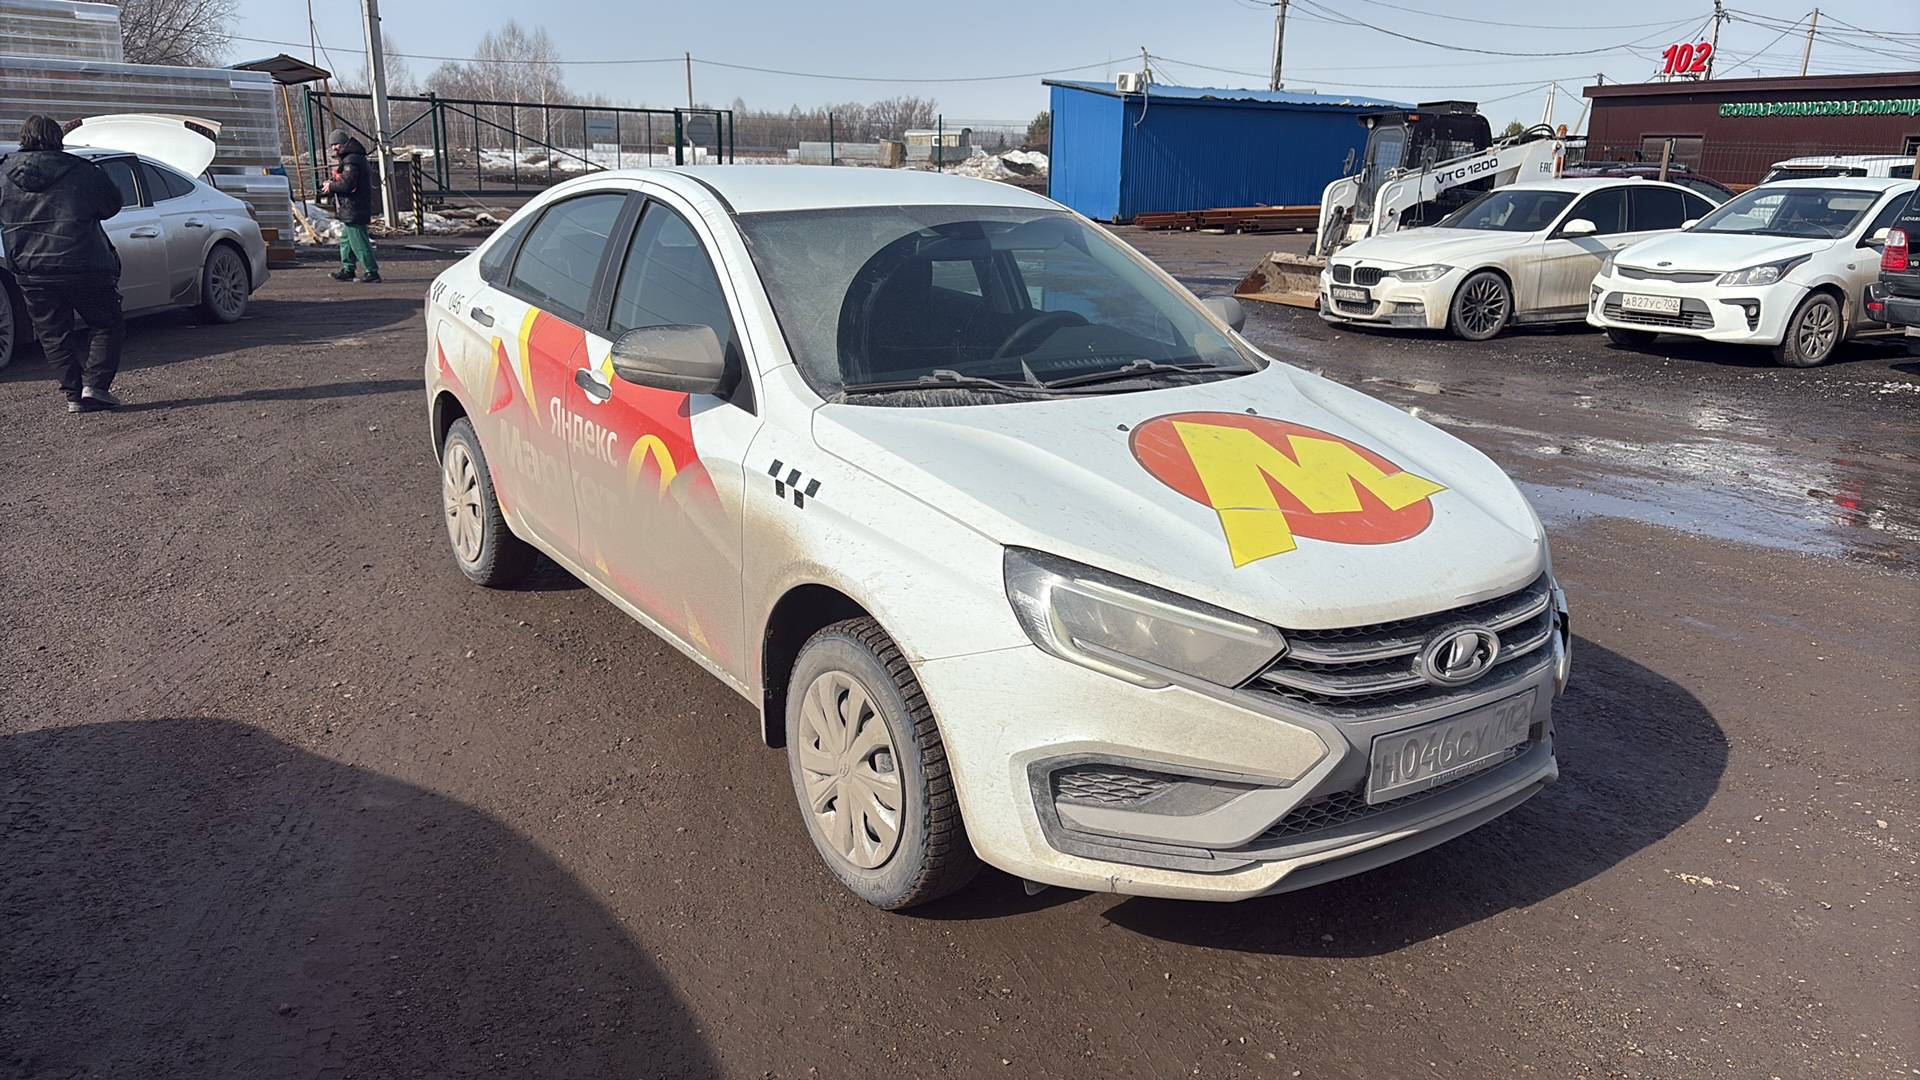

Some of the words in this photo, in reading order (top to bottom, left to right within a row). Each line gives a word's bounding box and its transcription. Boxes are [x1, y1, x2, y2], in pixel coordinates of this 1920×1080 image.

[1663, 43, 1712, 73] 102
[1435, 168, 1466, 184] VTG
[1467, 158, 1499, 175] 1200
[550, 396, 619, 470] Яндекс
